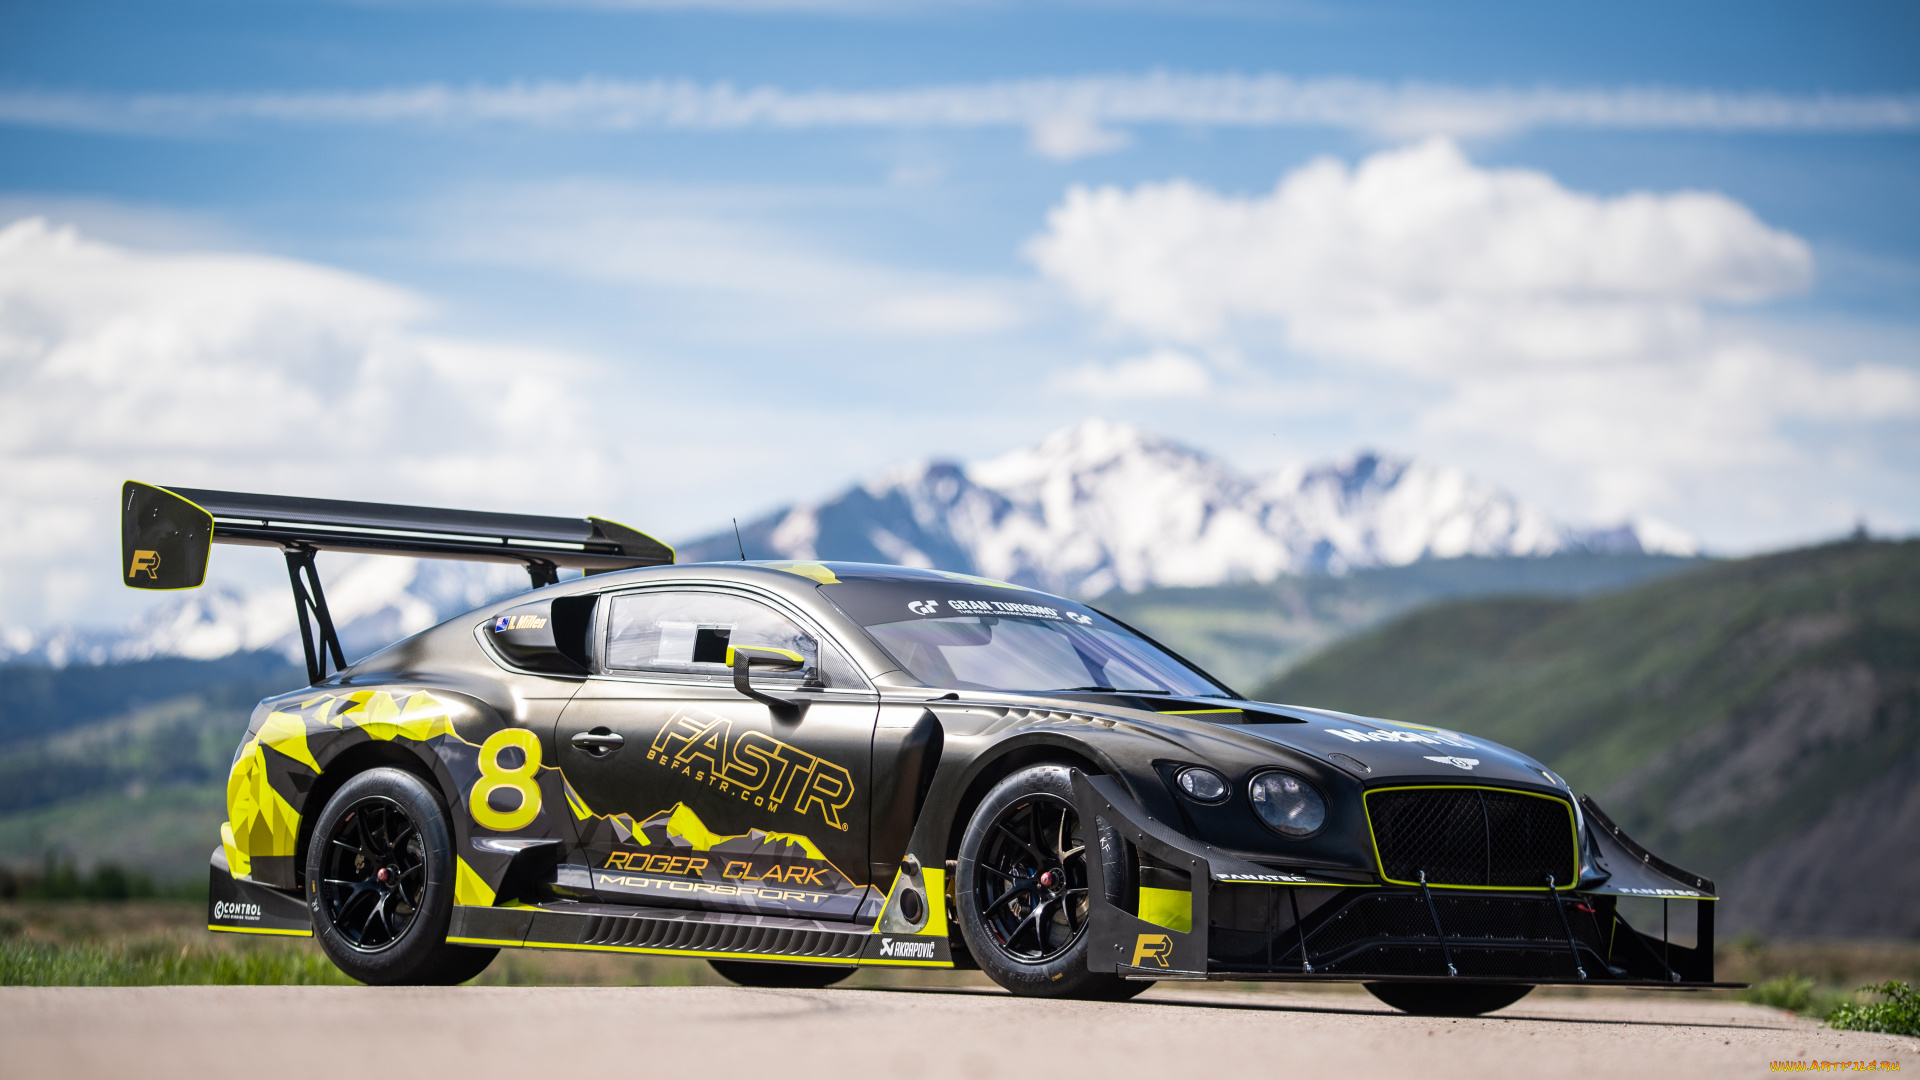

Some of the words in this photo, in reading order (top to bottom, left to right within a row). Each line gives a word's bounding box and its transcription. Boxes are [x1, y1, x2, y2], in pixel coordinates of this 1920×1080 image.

[947, 600, 993, 610] GRAN
[990, 601, 1059, 616] TURISMO
[515, 614, 548, 629] Millen
[651, 703, 855, 830] FASTR
[469, 727, 543, 832] 8
[646, 749, 779, 813] BEFASTR.COM
[604, 851, 709, 876] ROGER
[722, 860, 830, 886] CLARK
[1216, 873, 1307, 882] FANATEC
[599, 874, 829, 904] MOTORSPORT
[223, 902, 261, 916] CONTROL
[893, 941, 935, 958] AKRAPOVIČ
